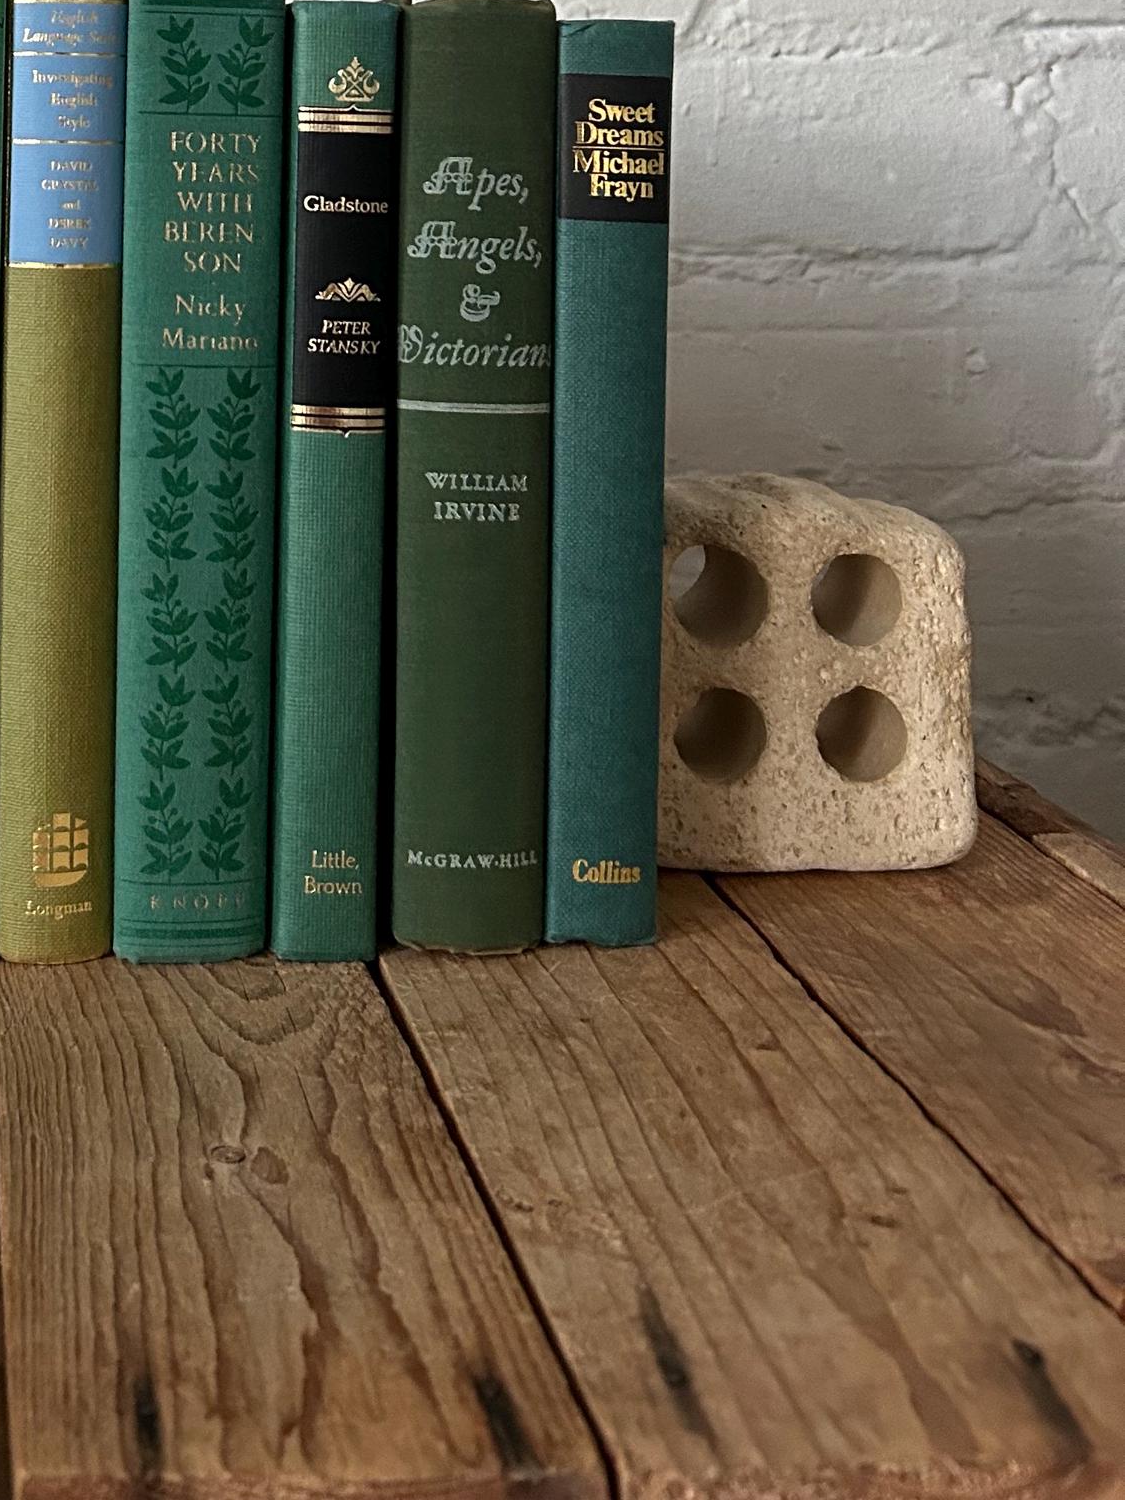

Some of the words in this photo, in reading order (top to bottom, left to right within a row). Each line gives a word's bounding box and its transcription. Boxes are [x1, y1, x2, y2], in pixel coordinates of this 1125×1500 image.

[588, 98, 655, 124] Sweet
[171, 131, 261, 154] FORTY
[575, 120, 665, 147] Dreams
[172, 161, 260, 184] YEARS
[572, 150, 666, 175] Michael
[422, 156, 529, 211] Apes,
[589, 173, 654, 203] Frayn
[177, 191, 253, 214] WITH
[303, 194, 389, 213] Gladstone
[163, 220, 254, 244] BEREN
[406, 220, 542, 275] Angels,
[183, 251, 242, 273] SON
[175, 294, 246, 326] Nicky
[459, 283, 501, 322] &
[321, 319, 371, 335] PETER
[162, 327, 259, 351] Mariano
[307, 337, 381, 354] STANSKY
[398, 323, 552, 368] Victorian
[424, 471, 528, 492] WILLIAM
[434, 501, 520, 522] IRVINE
[312, 850, 360, 870] Little,
[572, 859, 641, 884] Collins
[304, 875, 363, 894] Brown
[25, 900, 92, 919] Longman
